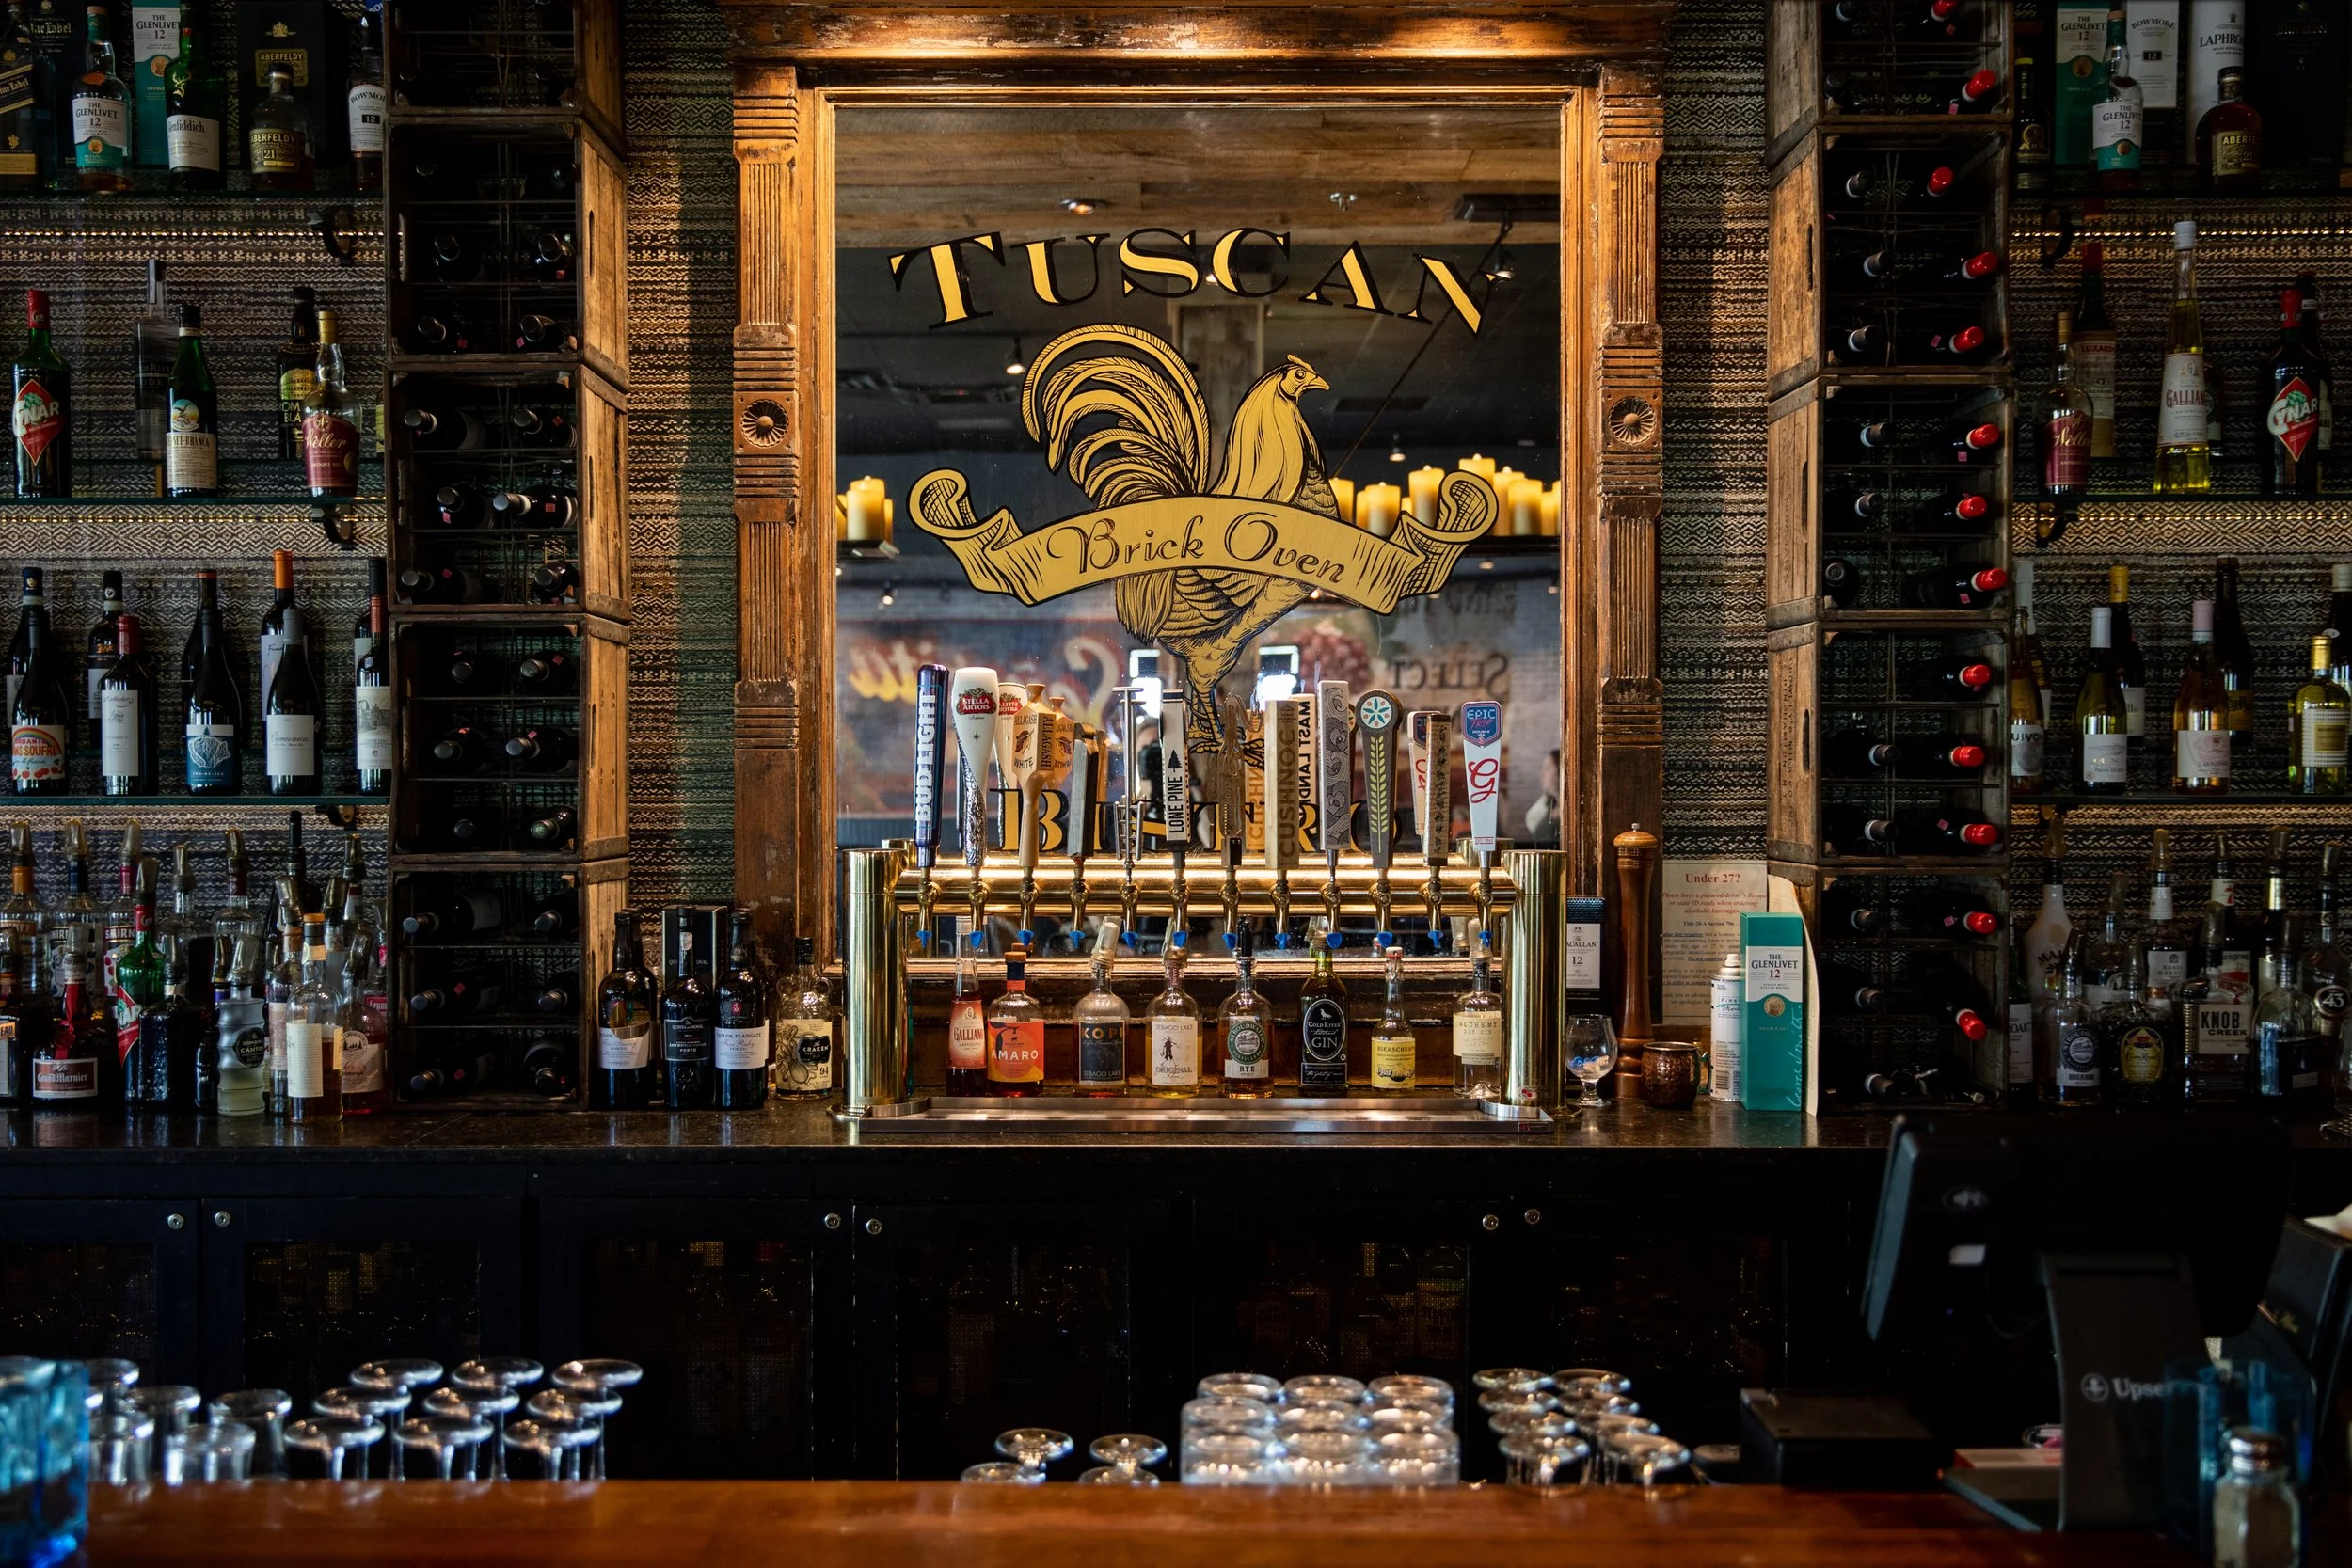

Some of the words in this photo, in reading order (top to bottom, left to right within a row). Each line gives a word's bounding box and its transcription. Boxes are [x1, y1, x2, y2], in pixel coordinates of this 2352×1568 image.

[30, 22, 45, 34] lue
[136, 21, 181, 30] GLENLIVET
[2061, 23, 2106, 31] GLENLIVET
[2131, 18, 2175, 30] BOWMORE
[154, 30, 166, 40] 12
[2078, 31, 2089, 40] 12
[2200, 33, 2246, 47] LAPHRO
[260, 53, 303, 61] ABERFELDY
[350, 90, 386, 103] BOWMO
[76, 108, 118, 119] GLENLIVET
[2103, 112, 2142, 122] GLENLIVET
[89, 118, 102, 127] 12
[364, 115, 378, 124] 12
[2120, 120, 2130, 130] 12
[250, 133, 296, 144] ABERFELDY
[2223, 135, 2259, 145] ABERFE
[263, 149, 277, 159] 21
[887, 227, 1504, 338] TUSCAN
[2166, 389, 2203, 408] GALLIA
[2266, 397, 2318, 436] CYNAR
[1046, 516, 1205, 575] Brick
[1225, 512, 1345, 584] Oven
[1014, 714, 1038, 725] ALLAGASH
[1467, 709, 1495, 720] EPIC
[917, 694, 936, 764] LIGHT
[1470, 719, 1493, 730] TRIP
[1041, 716, 1055, 768] ALLAGASH
[1014, 757, 1034, 769] WHITE
[1468, 758, 1499, 803] G
[916, 768, 933, 821] BUD
[1168, 776, 1183, 802] PINE
[1279, 727, 1296, 858] CUSHNOC
[1168, 803, 1184, 833] LONE
[1685, 873, 1719, 883] Under
[1723, 873, 1740, 883] 27?
[105, 927, 135, 939] SMIRN
[1572, 956, 1583, 965] 12
[1751, 960, 1799, 969] GLENLIVET
[1770, 969, 1781, 978] 12
[2322, 992, 2344, 1008] 43
[2201, 1011, 2240, 1029] KNOB
[1311, 1037, 1338, 1048] GIN
[2246, 1036, 2251, 1048] 9
[992, 1049, 1039, 1061] AMARO
[820, 1067, 829, 1075] 94
[56, 1072, 88, 1083] Marnier
